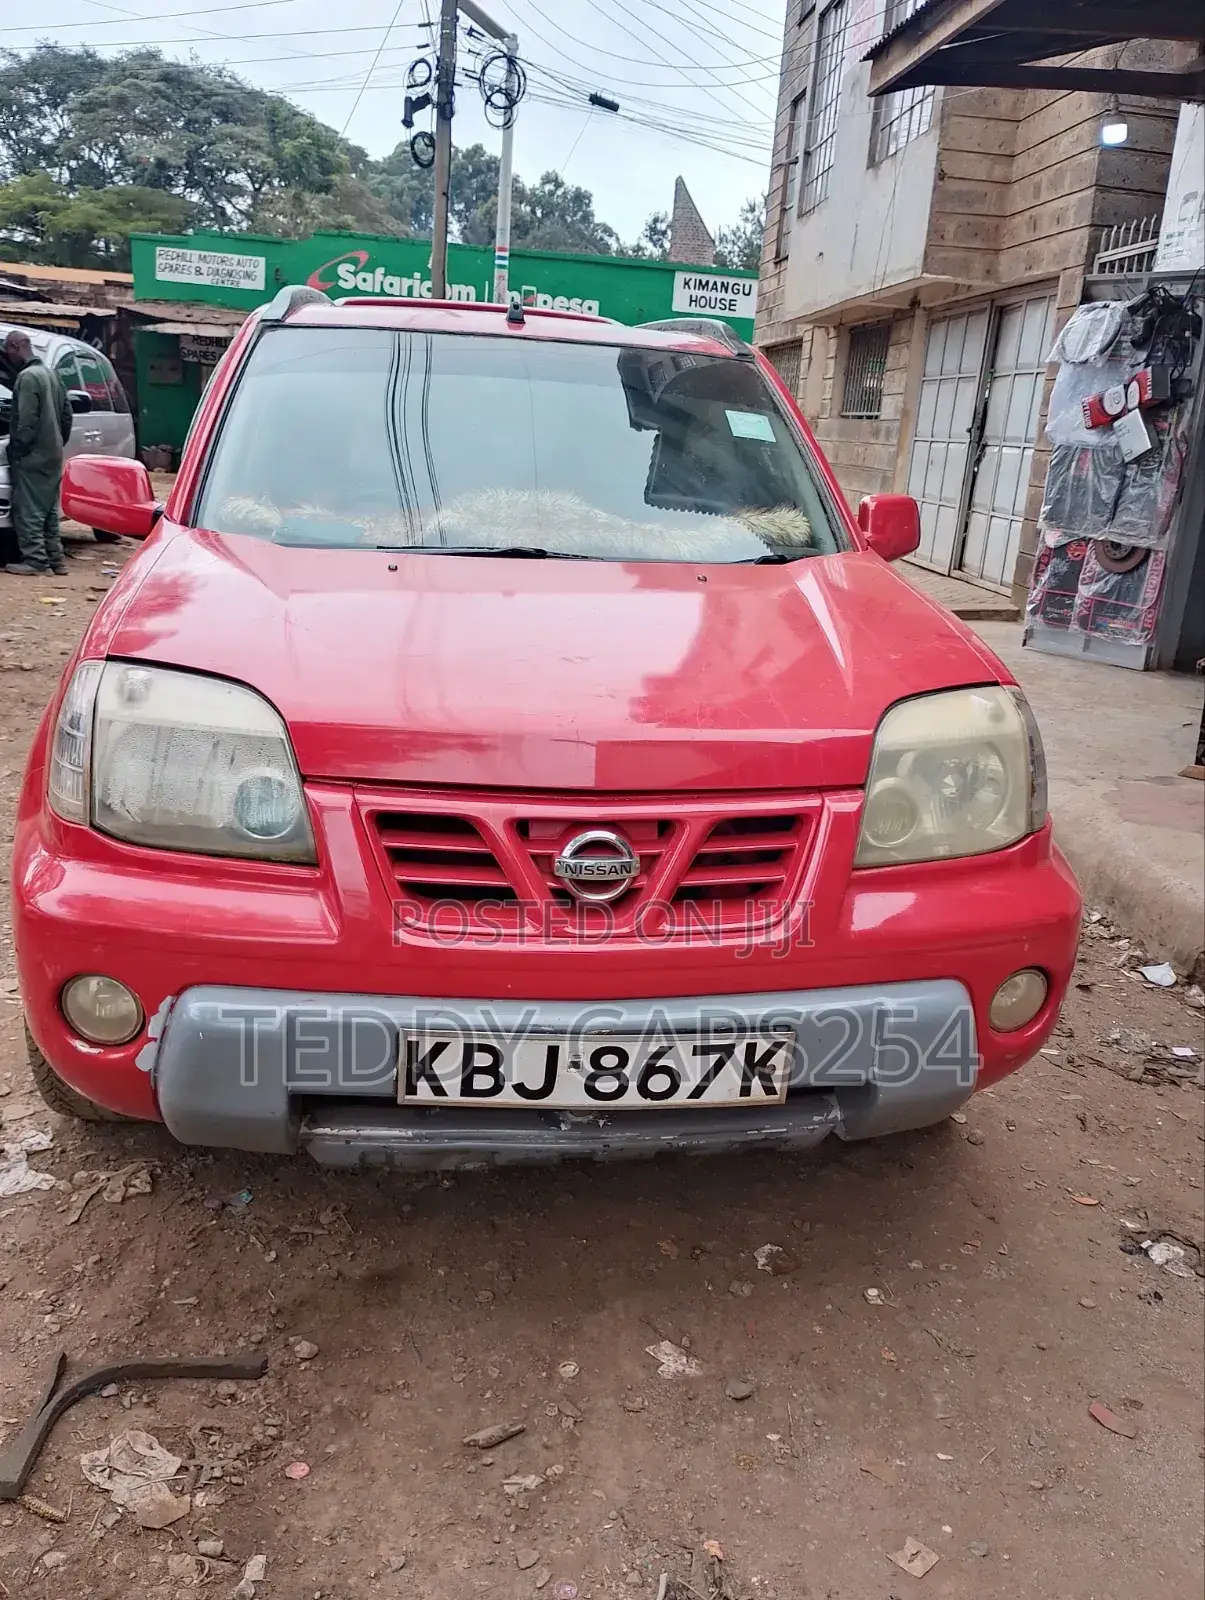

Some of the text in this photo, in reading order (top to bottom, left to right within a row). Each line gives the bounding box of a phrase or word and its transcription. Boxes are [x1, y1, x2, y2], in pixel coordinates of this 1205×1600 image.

[158, 249, 260, 269] REDHILL MOTORS AUTO
[157, 262, 258, 282] SPARES & DIAGNOSING
[210, 278, 241, 288] CENTRE
[683, 277, 752, 296] KIMANGU
[689, 294, 737, 312] HOUSE
[180, 347, 217, 361] SPARES
[564, 863, 632, 876] NISSAN
[405, 1039, 789, 1102] KBJ 867K
